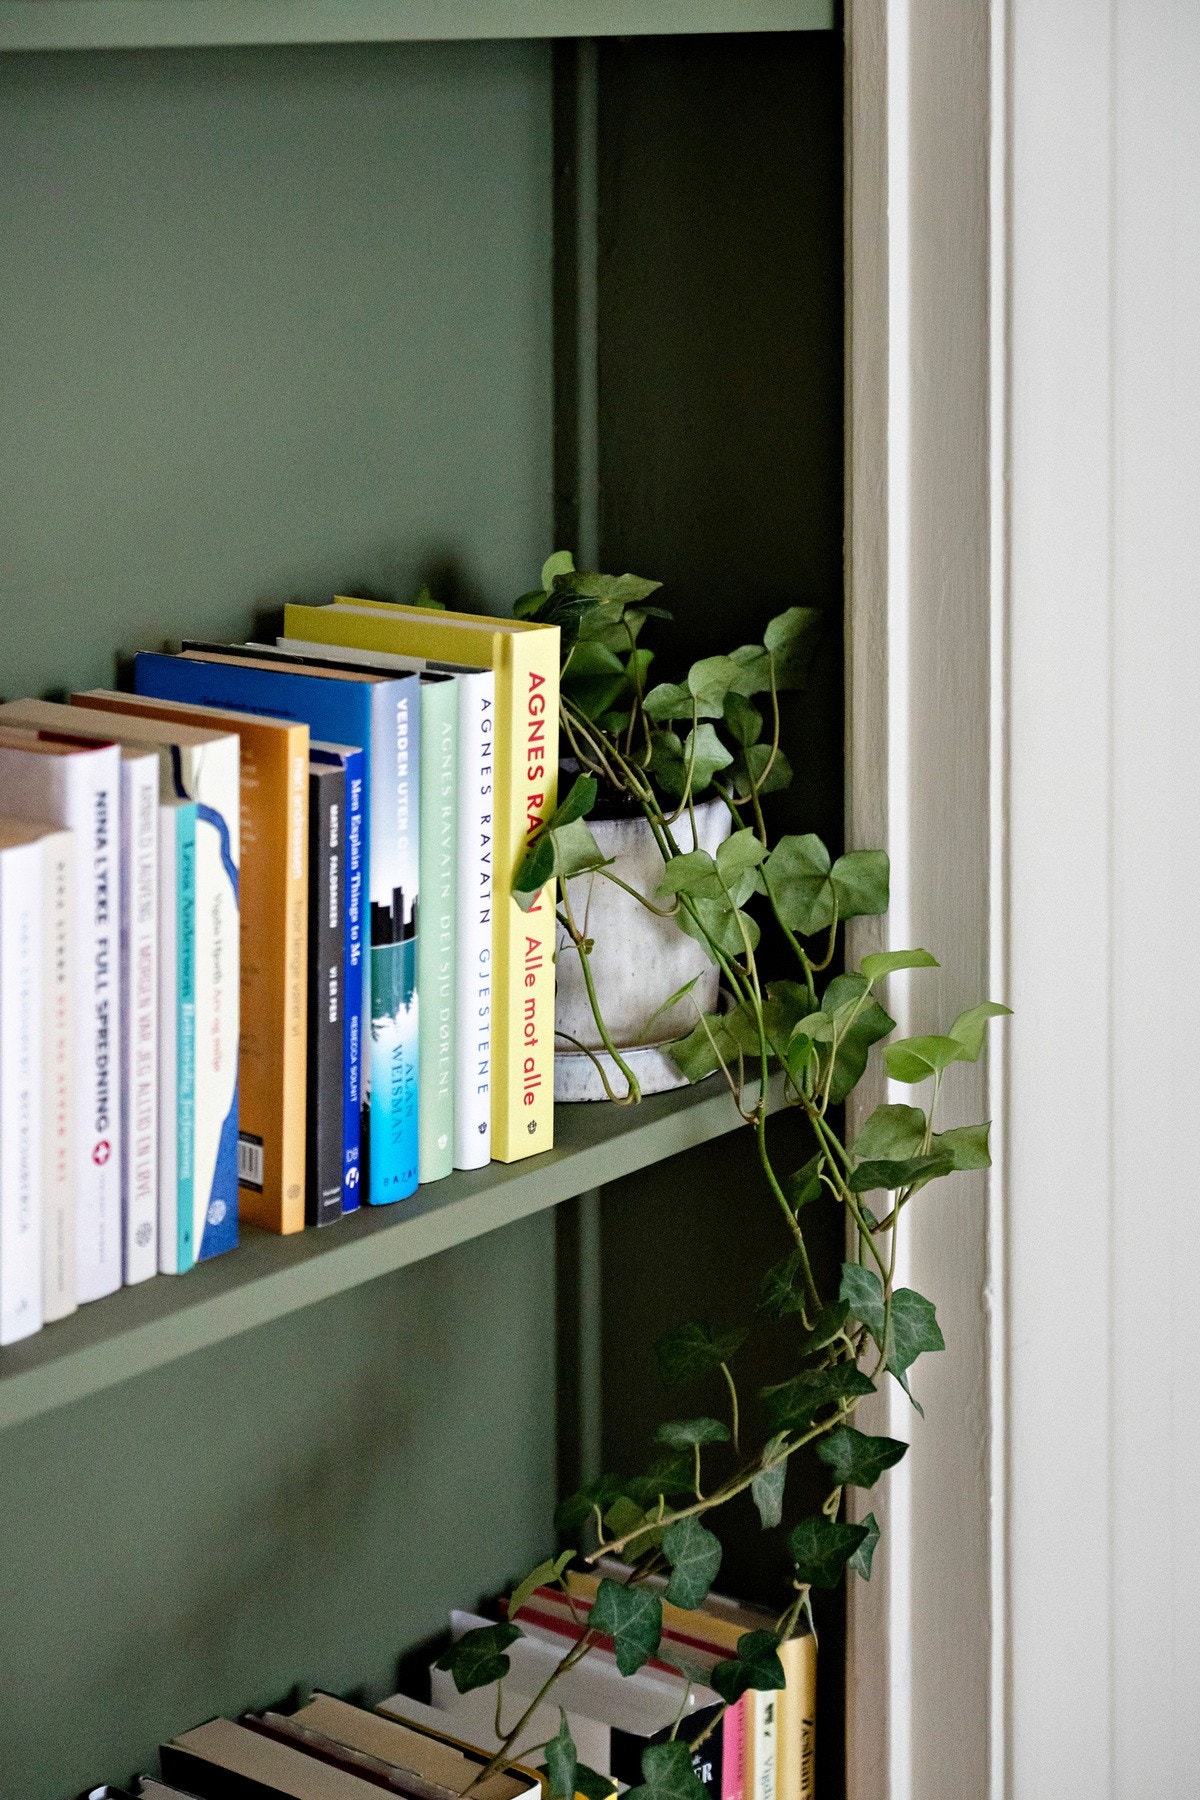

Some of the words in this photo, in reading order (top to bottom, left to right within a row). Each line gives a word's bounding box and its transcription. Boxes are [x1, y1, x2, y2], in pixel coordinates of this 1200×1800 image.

[397, 698, 408, 778] VERDEN
[481, 699, 492, 795] AGNES
[528, 672, 545, 781] AGNES
[442, 722, 452, 796] AGNES
[95, 791, 109, 849] NINA
[350, 779, 362, 811] Men
[397, 782, 408, 831] UTEN
[329, 804, 339, 848] MATIAS
[348, 814, 362, 870] Explain
[441, 805, 452, 898] RAVATN
[526, 793, 545, 913] RAVN
[94, 856, 109, 927] LYKKE
[329, 855, 339, 928] FALDBAKKEN
[480, 814, 491, 924] RAVATN
[347, 872, 362, 924] Things
[350, 925, 361, 941] to
[350, 943, 361, 966] Me
[440, 915, 451, 953] DEI
[95, 938, 109, 992] FULL
[329, 966, 338, 978] VI
[329, 980, 338, 996] ER
[439, 961, 451, 999] SJU
[525, 936, 543, 987] Alle
[329, 998, 338, 1023] FEM
[478, 949, 490, 1095] GJESTENE
[524, 997, 540, 1047] mot
[350, 1015, 359, 1063] REBECCA
[439, 1007, 450, 1100] DØRENE
[94, 1000, 110, 1133] SPREDNING
[349, 1065, 359, 1104] SOLNIT
[405, 1062, 414, 1118] ALAN
[524, 1057, 542, 1106] alle
[391, 1044, 403, 1145] WEISMAN
